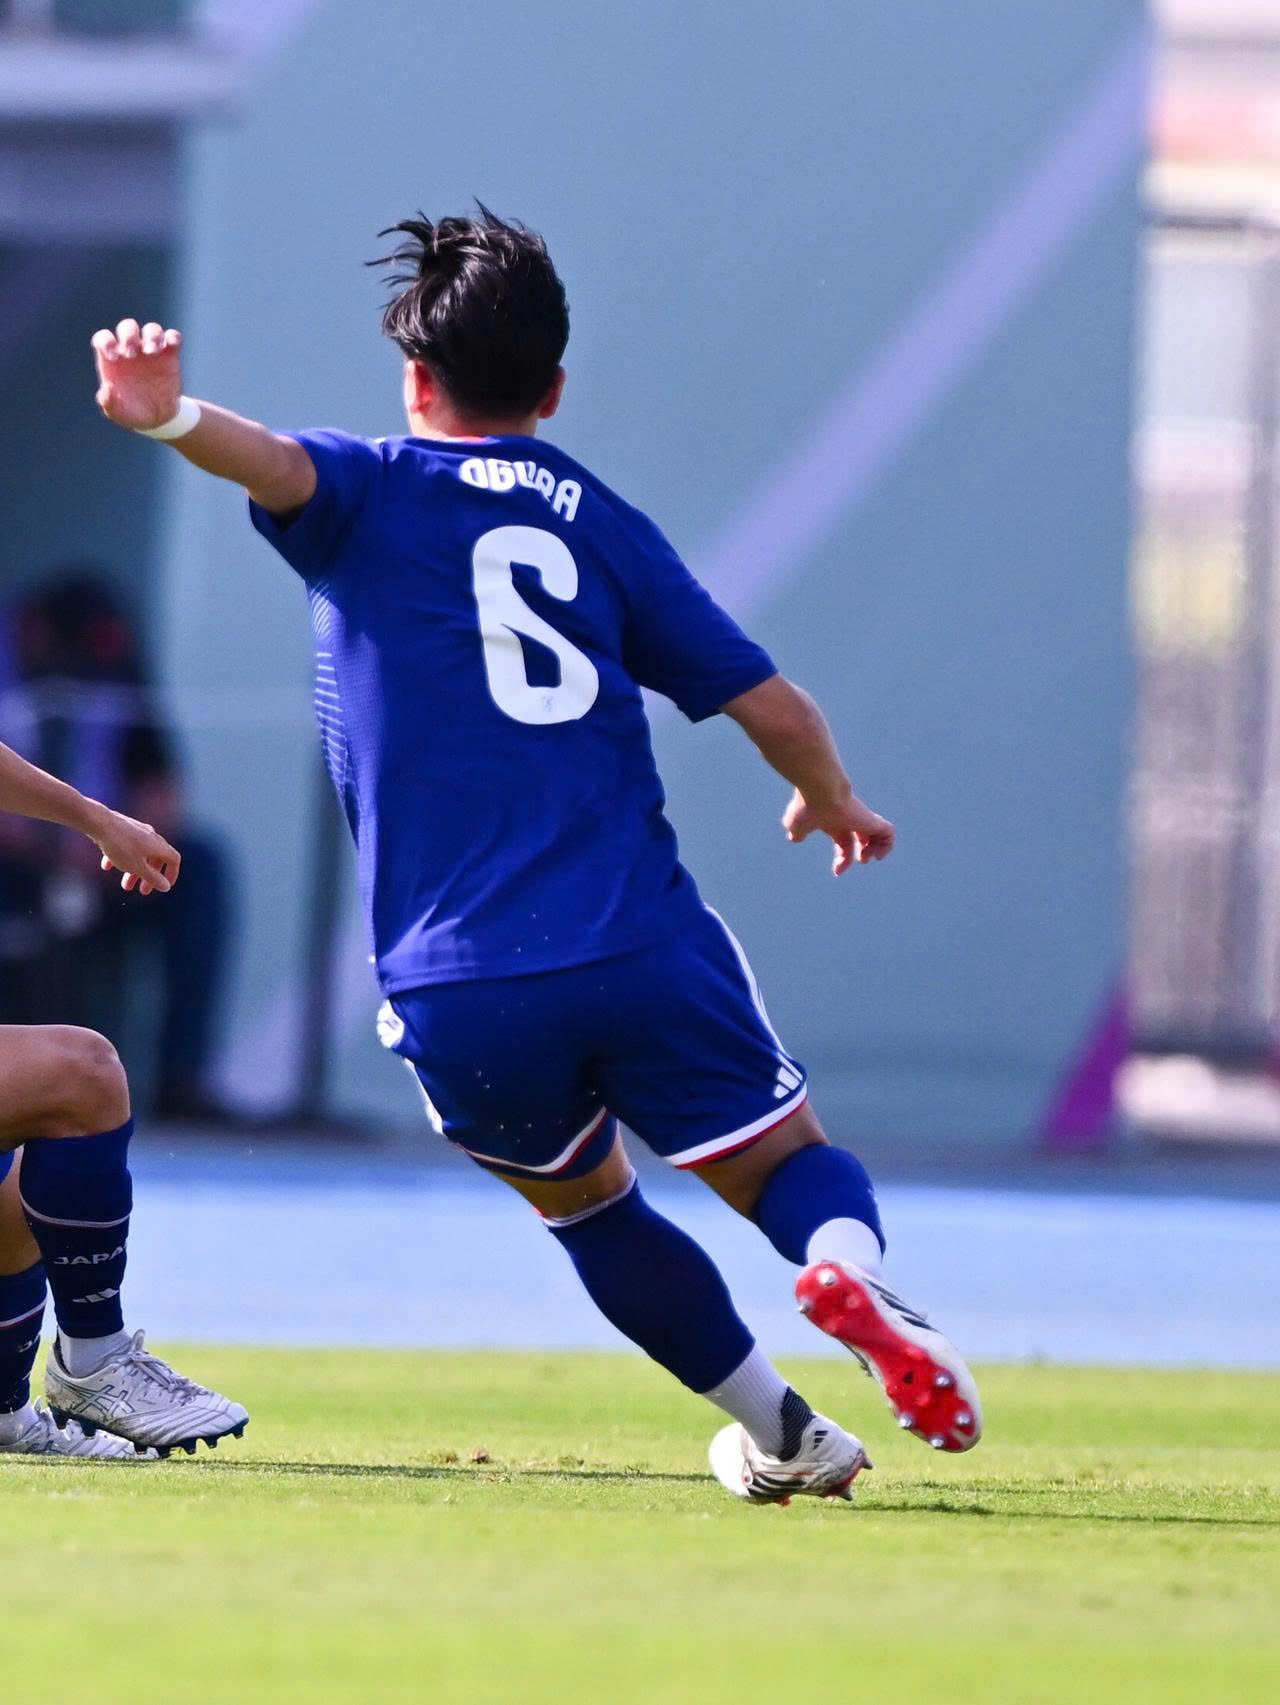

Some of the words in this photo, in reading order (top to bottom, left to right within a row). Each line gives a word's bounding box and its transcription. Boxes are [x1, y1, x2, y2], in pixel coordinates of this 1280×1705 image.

[459, 457, 582, 522] OGURA
[472, 525, 599, 726] 6
[53, 1243, 127, 1265] JAPA
